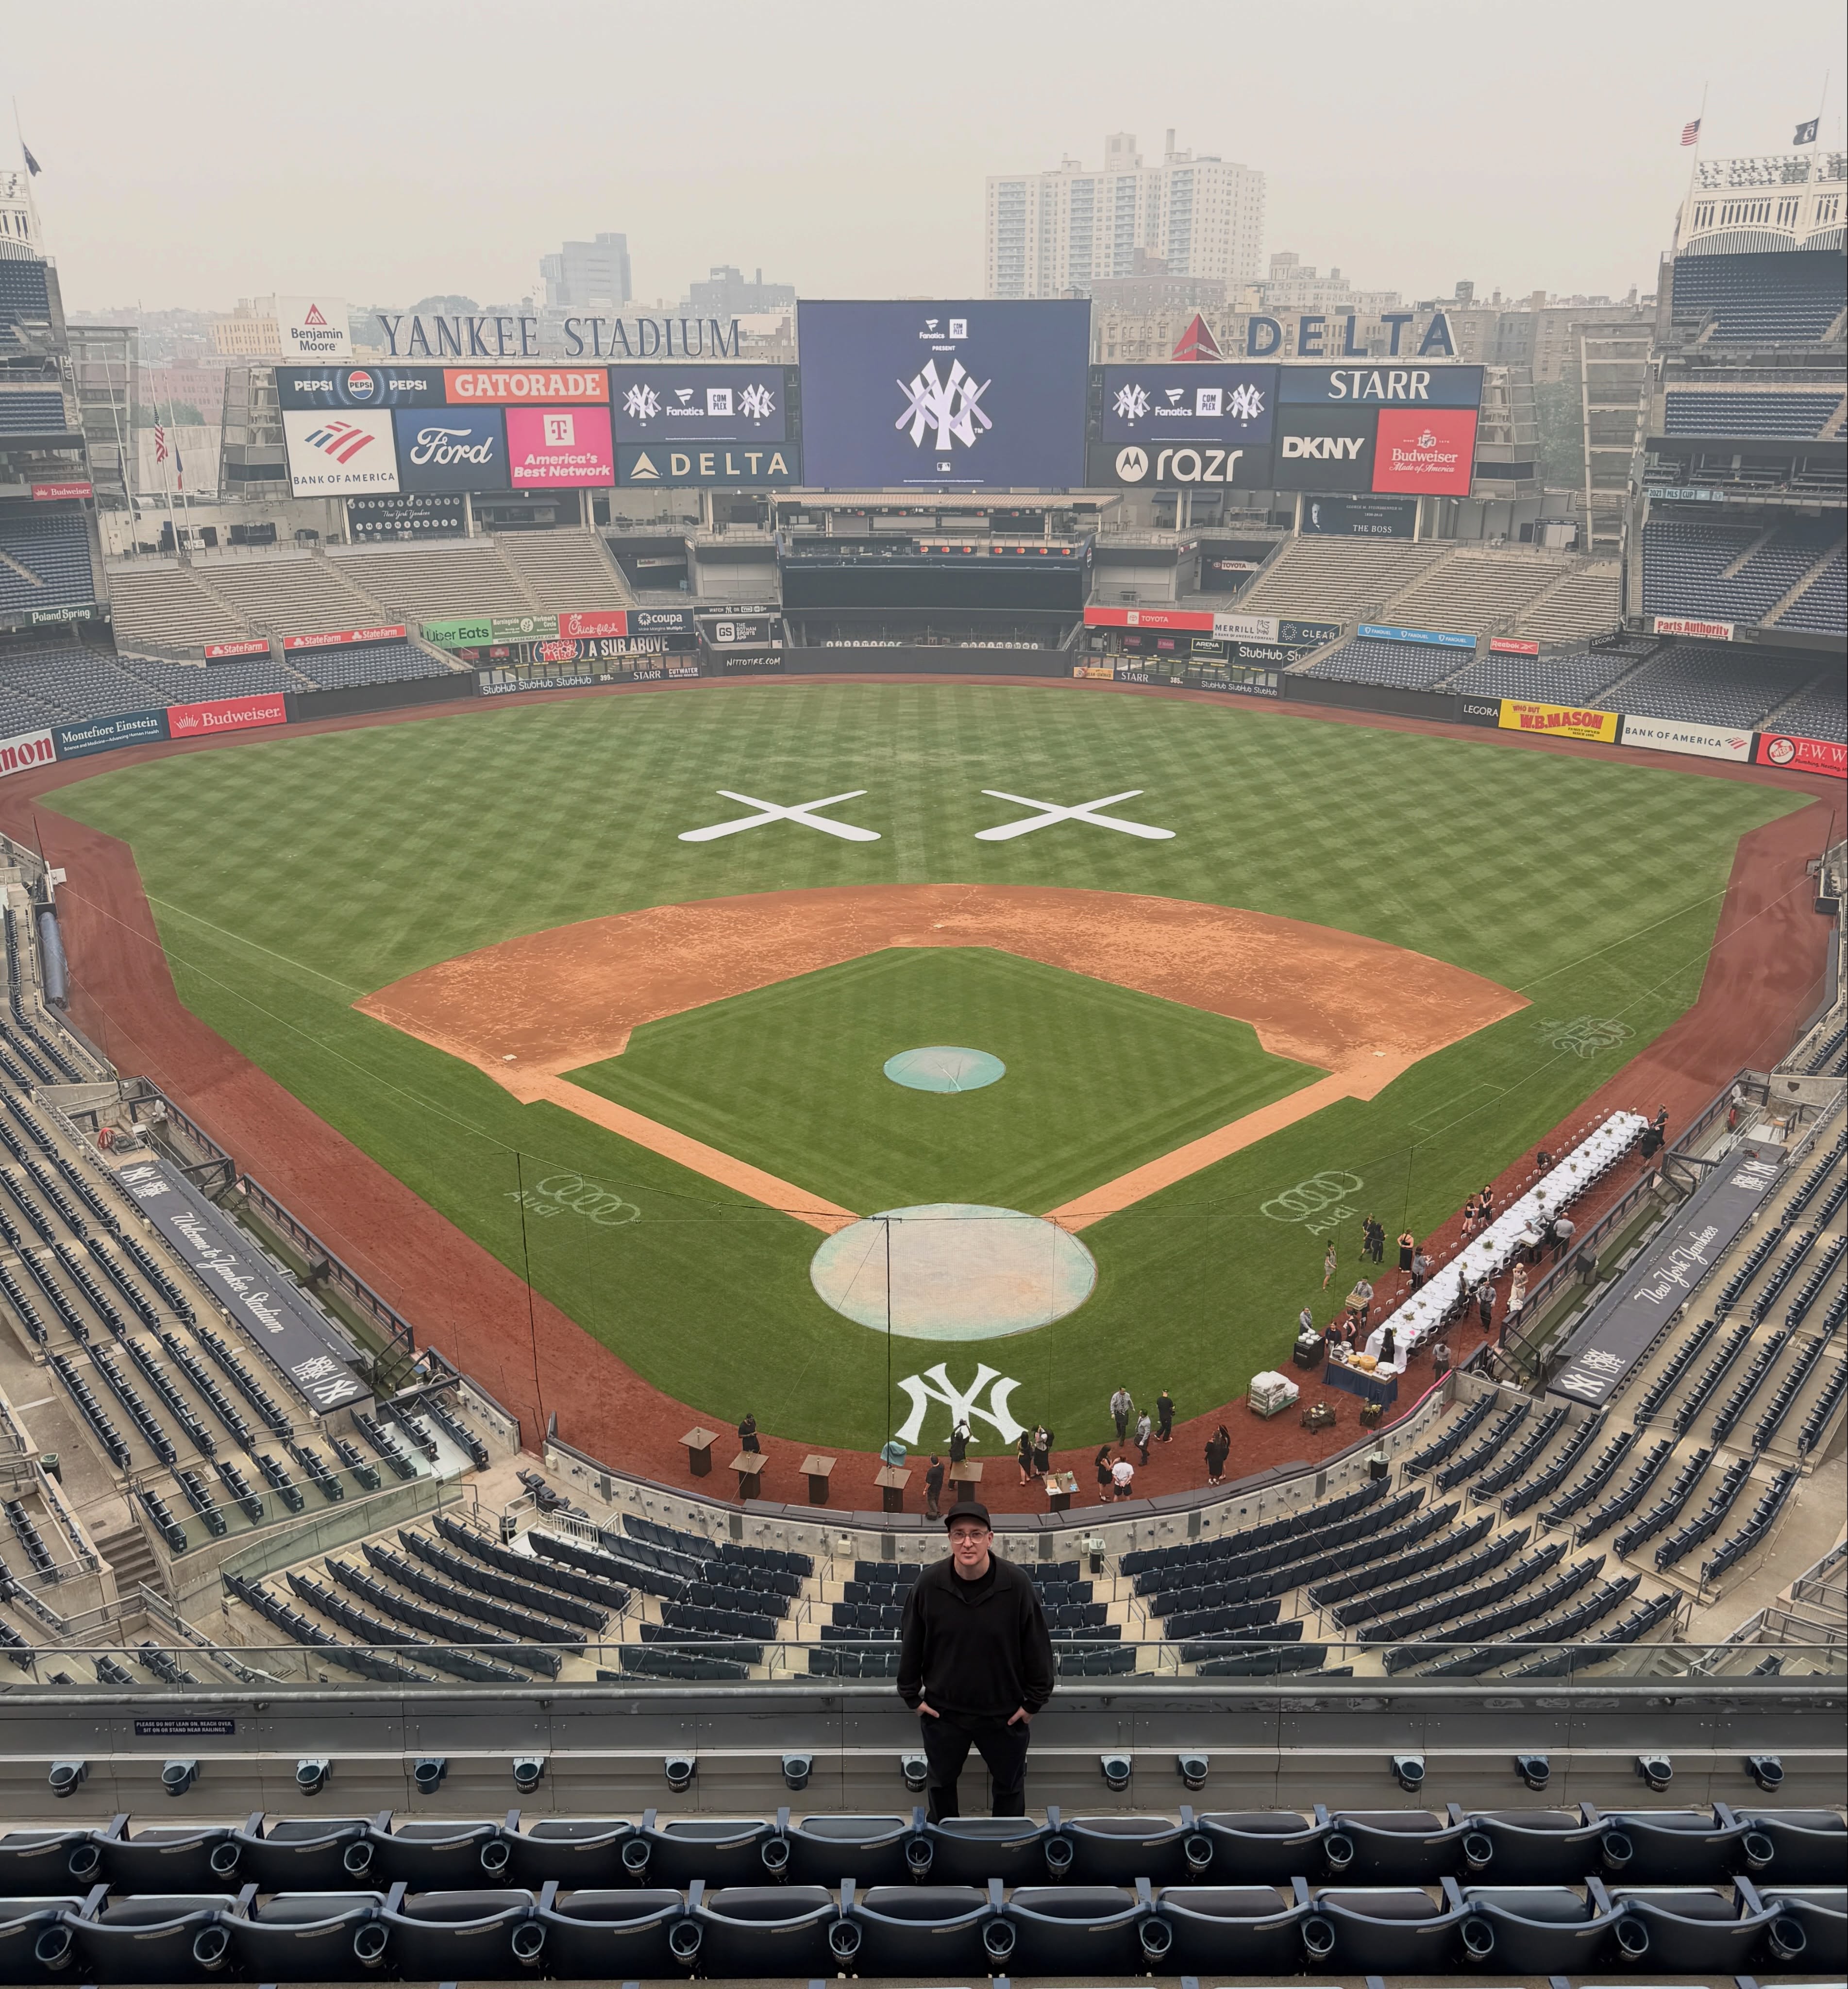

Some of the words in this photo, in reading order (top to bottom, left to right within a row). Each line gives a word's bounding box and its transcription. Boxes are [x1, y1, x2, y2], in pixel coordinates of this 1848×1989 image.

[291, 327, 343, 341] Benjamin
[376, 315, 539, 356] YANKEE
[564, 318, 741, 357] STADIUM
[920, 331, 945, 339] Fanatics
[1246, 314, 1458, 357] DELTA
[300, 340, 336, 351] Moore
[294, 380, 333, 391] PEPSI
[389, 380, 427, 390] PEPSI
[455, 373, 600, 397] GATORADE
[1328, 370, 1430, 400] STARR
[713, 394, 726, 403] COM
[1202, 394, 1216, 403] COM
[666, 406, 704, 416] Fanatics
[713, 402, 727, 411] PLEX
[1155, 406, 1192, 417] Fanatics
[1202, 402, 1216, 411] PLEX
[410, 427, 493, 465] Ford
[1282, 436, 1365, 460] DKNY
[524, 454, 598, 466] America's
[1392, 448, 1458, 463] Budweiser
[670, 452, 788, 475] DELTA
[1157, 449, 1243, 482] razr
[1389, 462, 1414, 471] Made
[1414, 464, 1422, 473] of
[1422, 463, 1455, 472] America
[293, 474, 324, 485] BANK
[328, 473, 342, 483] OF
[345, 472, 395, 483] AMERICA
[514, 466, 545, 478] Best
[549, 465, 610, 477] Network
[50, 488, 90, 497] Budweiser
[394, 510, 408, 520] York
[407, 510, 430, 519] Yankees
[32, 610, 61, 624] Poland
[62, 608, 91, 620] Spring
[652, 614, 683, 625] coupa
[426, 630, 455, 643] Uber
[459, 627, 489, 639] Eats
[719, 627, 732, 636] GS
[1215, 624, 1254, 634] MERRILL
[1302, 630, 1335, 640] CLEAR
[1658, 621, 1682, 631] Parts
[1684, 622, 1729, 636] Authority
[539, 639, 577, 651] Jersey
[589, 641, 598, 657] A
[630, 636, 669, 652] ABOVE
[1492, 640, 1519, 649] Reebok
[1592, 635, 1615, 646] LEGORA
[1239, 646, 1282, 660] StubHub
[726, 657, 781, 667] NITTOTIRE.COM
[633, 671, 661, 680] STARR
[1121, 672, 1149, 682] STARR
[483, 682, 516, 695] StubHub
[519, 679, 553, 691] StubHub
[556, 675, 592, 687] StubHub
[1201, 681, 1226, 689] StubHub
[1228, 684, 1252, 692] StubHub
[1254, 687, 1277, 696] StubHub
[202, 707, 280, 727] Budweiser
[1463, 704, 1498, 717] LEGORA
[62, 726, 114, 743] Montefiore
[116, 717, 158, 732] Einstein
[1625, 727, 1653, 739] BANK
[1657, 731, 1671, 741] OF
[1672, 733, 1722, 747] AMERICA
[1798, 742, 1827, 759] F.W.
[504, 1191, 565, 1217] Audi
[1305, 1205, 1359, 1236] Audi
[170, 1212, 210, 1257] Welcome
[202, 1248, 218, 1262] to
[1634, 1281, 1671, 1304] New
[1653, 1256, 1691, 1288] York
[1672, 1226, 1719, 1265] Yankees
[196, 1254, 249, 1293] Yankee
[240, 1292, 285, 1333] Stadium
[895, 1363, 1028, 1445] NY
